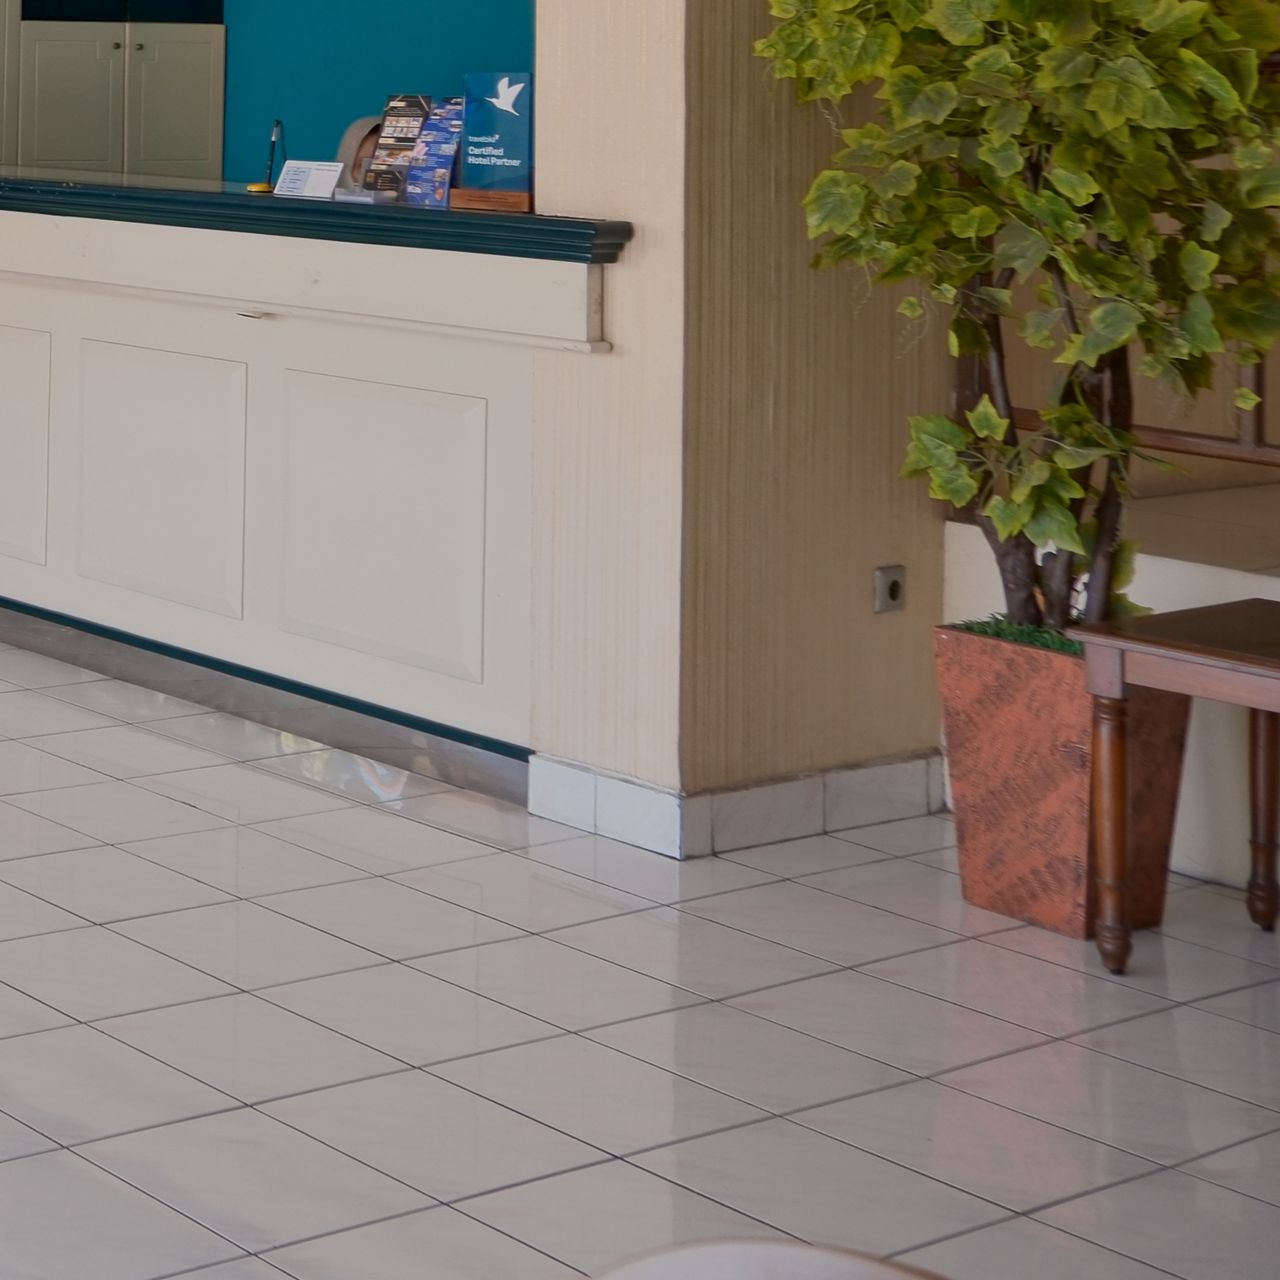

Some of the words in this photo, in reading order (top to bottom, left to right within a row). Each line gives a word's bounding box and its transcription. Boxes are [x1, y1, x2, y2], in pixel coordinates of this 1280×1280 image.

[468, 146, 504, 156] Certified
[468, 156, 490, 165] Hotel
[491, 157, 522, 166] Partner
